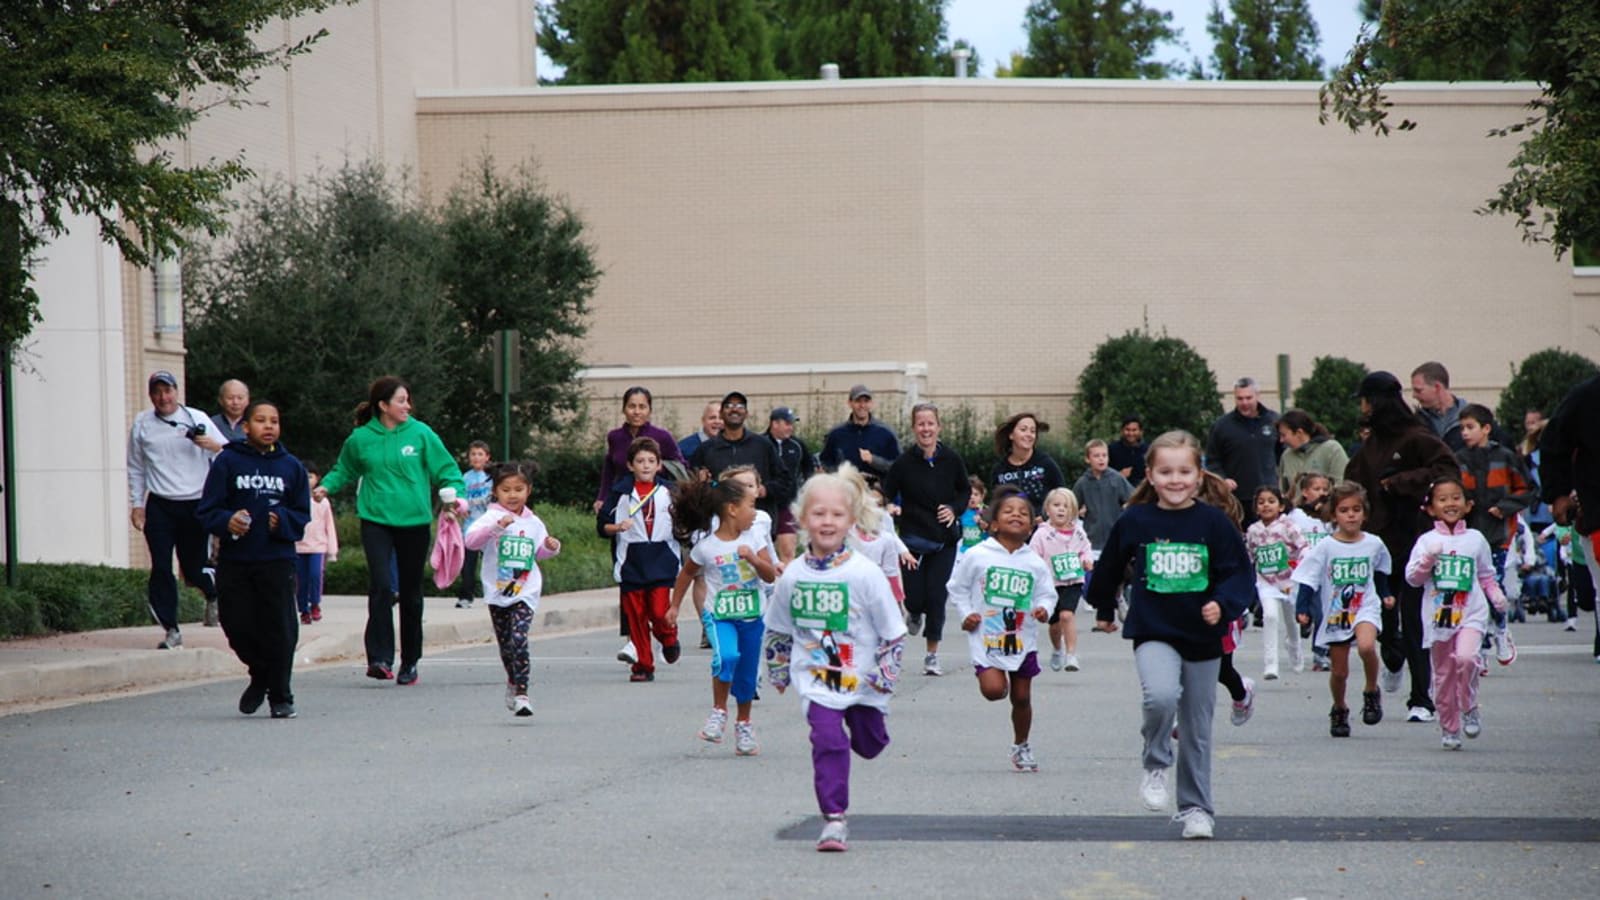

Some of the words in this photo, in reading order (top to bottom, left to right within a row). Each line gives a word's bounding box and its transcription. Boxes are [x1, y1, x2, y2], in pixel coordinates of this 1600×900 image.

[236, 475, 285, 491] NOVA
[1151, 552, 1202, 574] 3095
[1333, 562, 1367, 579] 3140
[1434, 560, 1470, 578] 3114
[989, 572, 1030, 595] 3108
[717, 595, 754, 614] 3161
[792, 588, 845, 613] 3138
